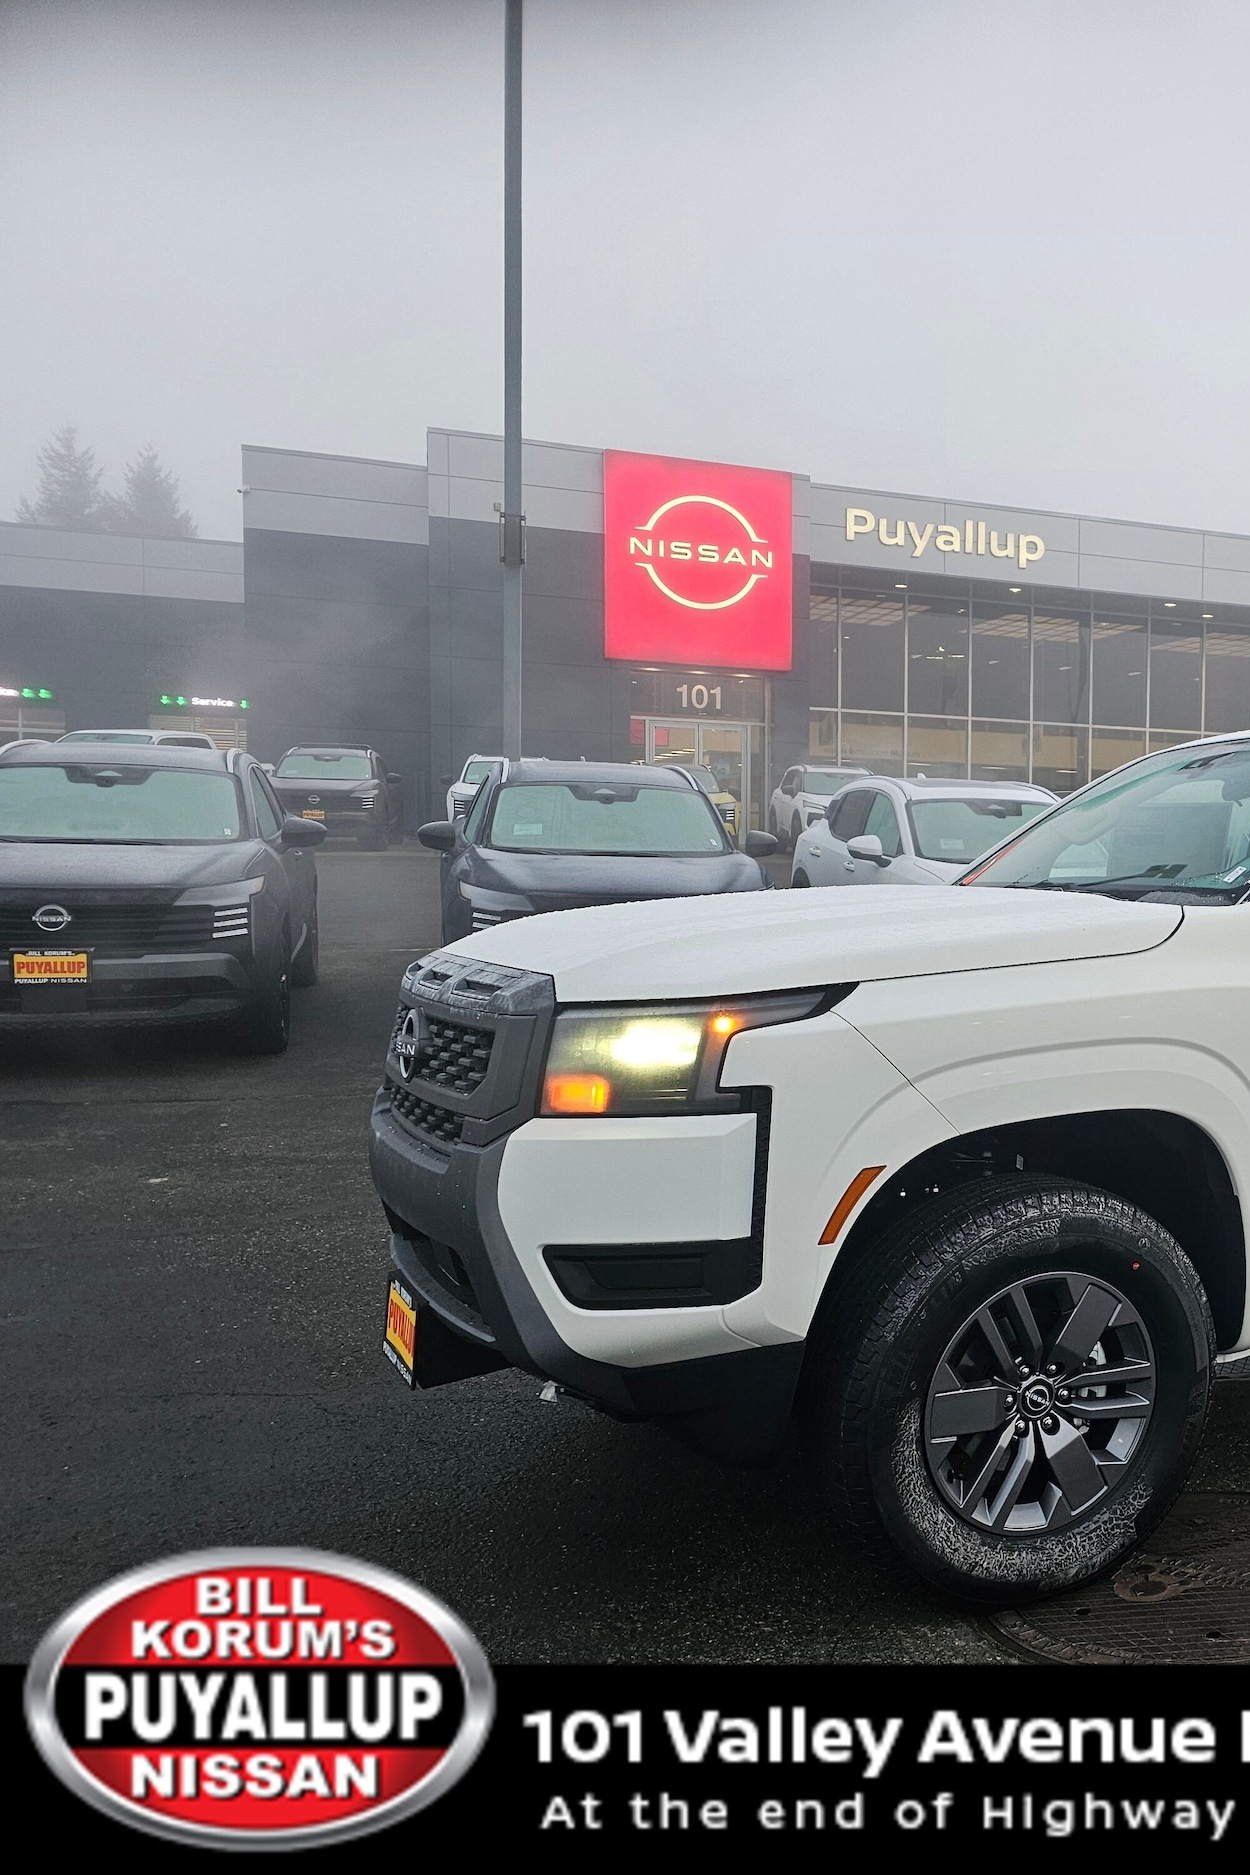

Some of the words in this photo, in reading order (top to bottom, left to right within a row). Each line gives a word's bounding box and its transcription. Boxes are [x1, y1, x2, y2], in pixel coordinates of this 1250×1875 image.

[846, 508, 1046, 569] Puyallup
[629, 536, 774, 569] NISSAN
[191, 696, 236, 708] Service
[676, 684, 722, 710] 101
[16, 961, 86, 974] PUYALLUP
